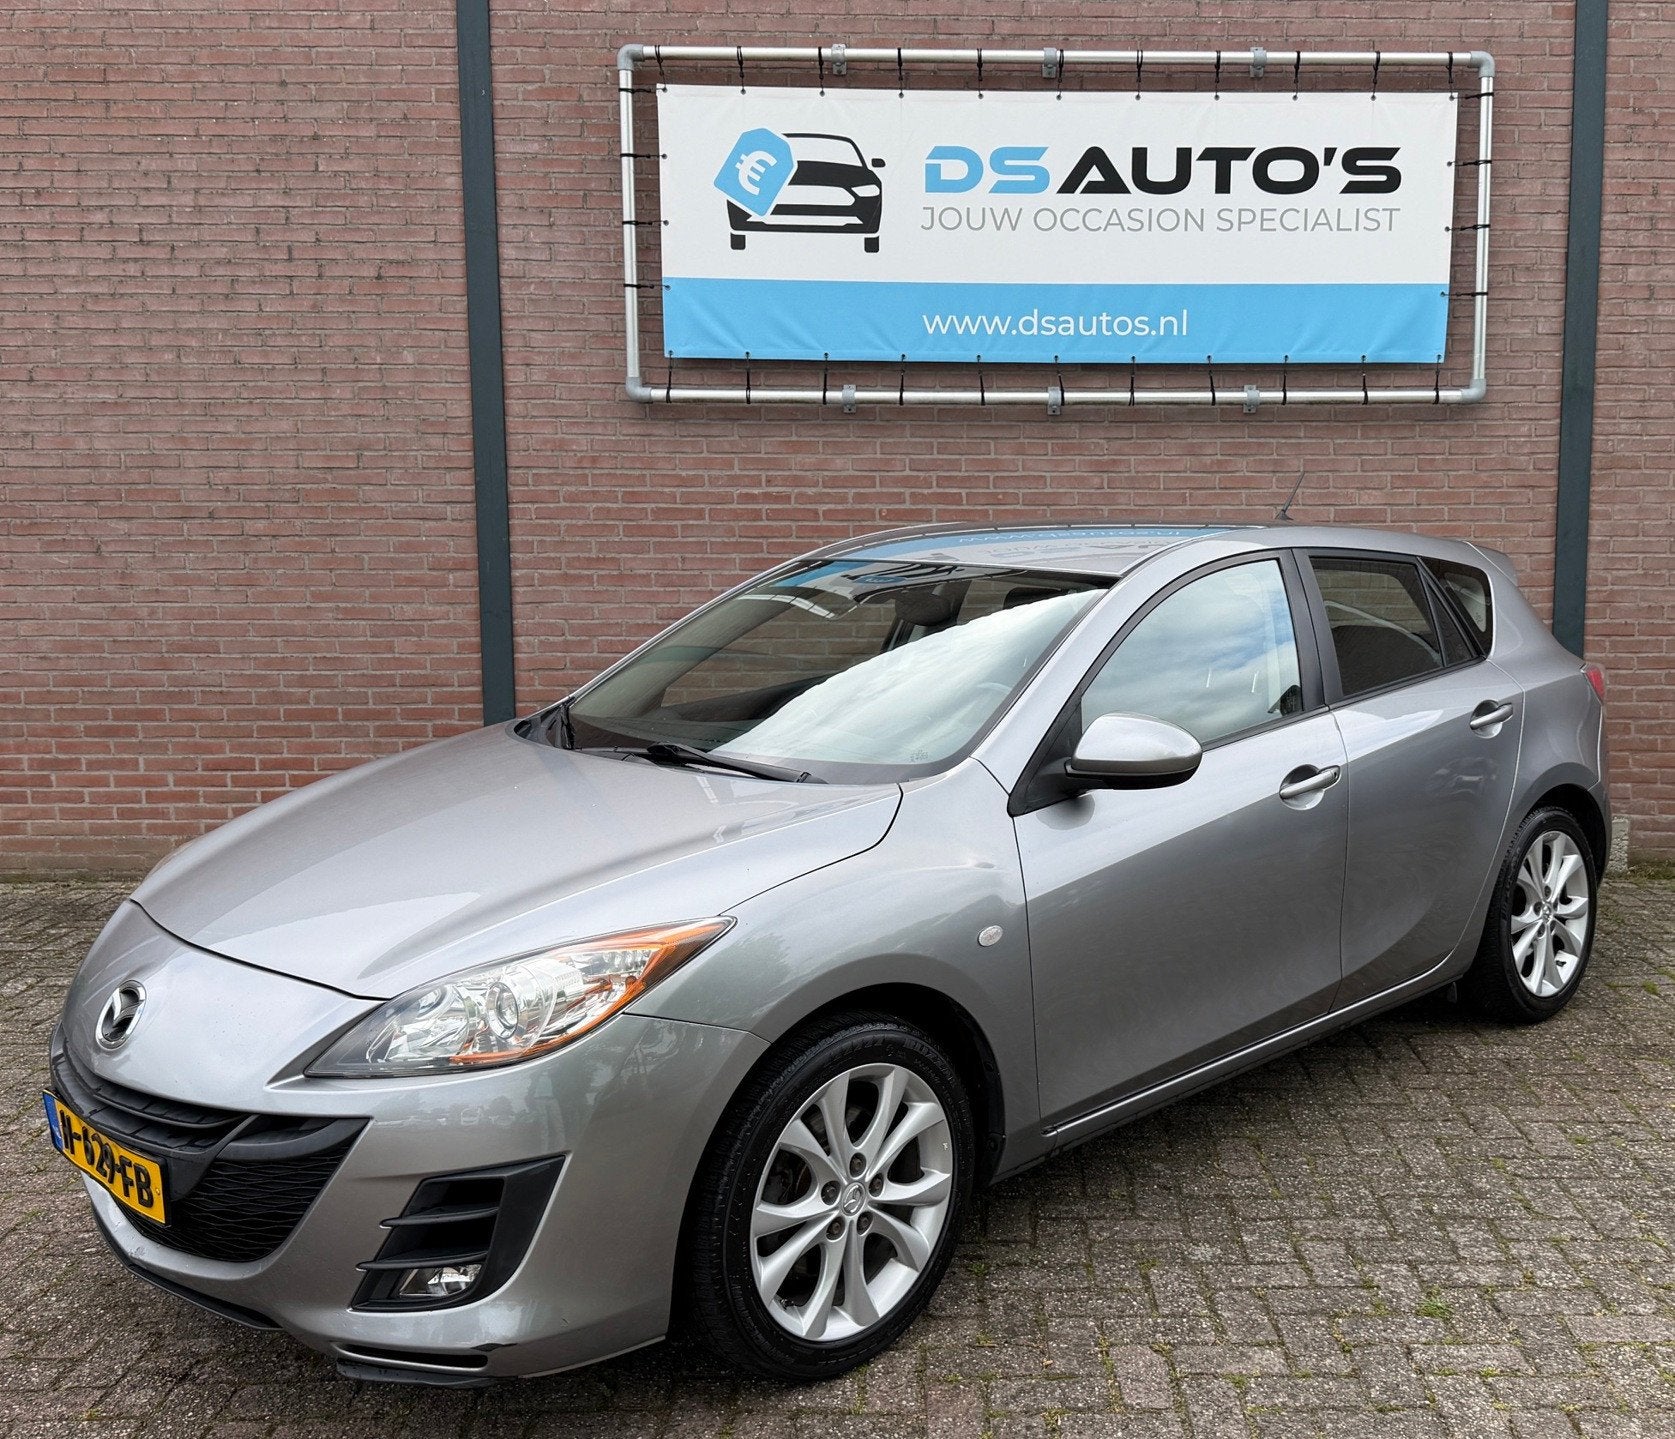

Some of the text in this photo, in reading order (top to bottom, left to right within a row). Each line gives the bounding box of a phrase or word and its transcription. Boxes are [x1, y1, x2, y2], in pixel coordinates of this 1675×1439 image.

[921, 206, 1400, 232] JOUW OCCASION SPECIALIST
[922, 308, 1188, 336] www.dsautos.nl
